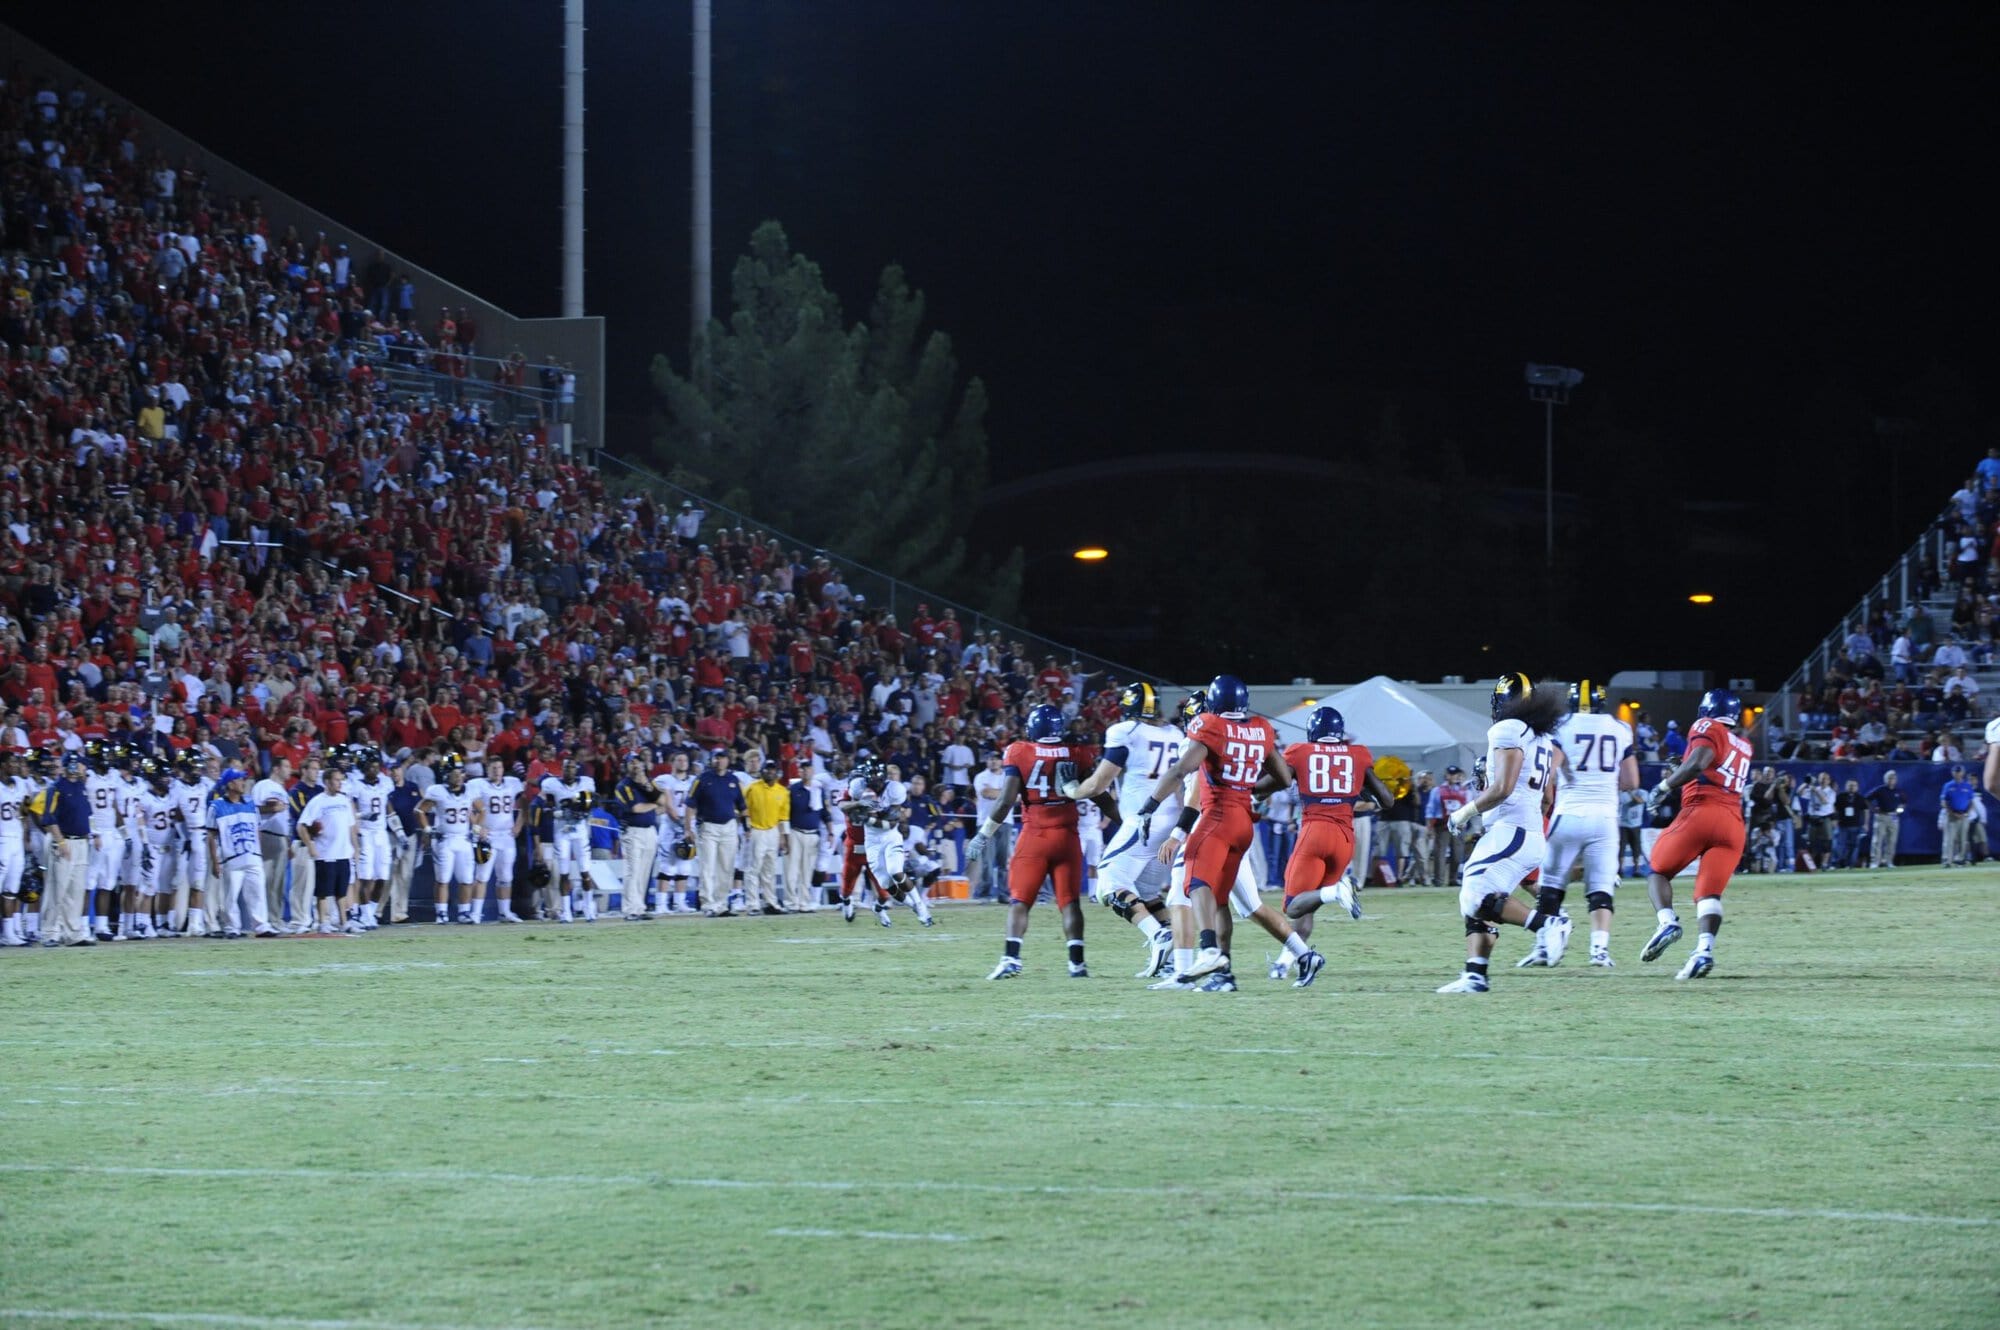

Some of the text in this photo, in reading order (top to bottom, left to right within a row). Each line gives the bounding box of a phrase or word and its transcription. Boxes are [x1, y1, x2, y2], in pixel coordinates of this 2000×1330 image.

[1148, 741, 1180, 779] 72
[1222, 741, 1265, 783] 33
[1574, 734, 1617, 772] 70
[1309, 754, 1353, 793] 83
[188, 797, 200, 814] 7
[445, 807, 469, 824] 33
[490, 795, 511, 814] 68
